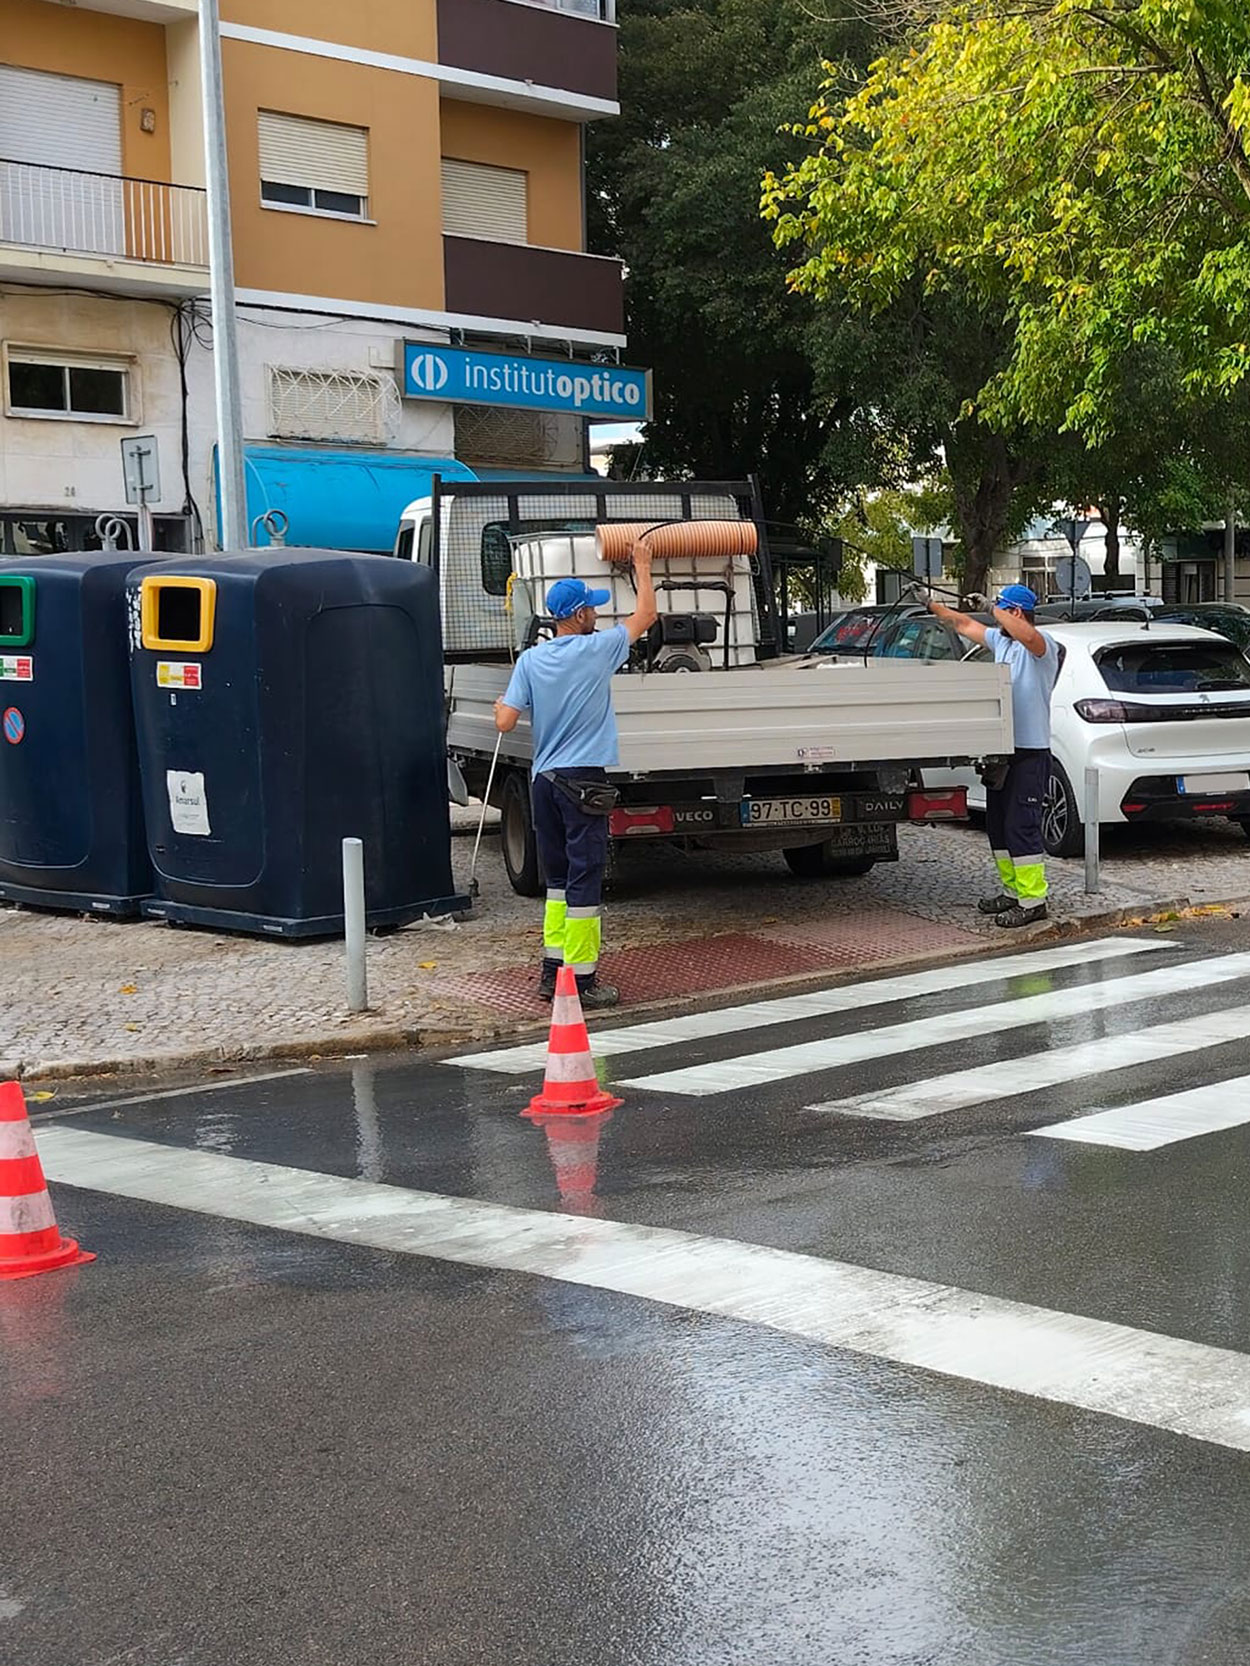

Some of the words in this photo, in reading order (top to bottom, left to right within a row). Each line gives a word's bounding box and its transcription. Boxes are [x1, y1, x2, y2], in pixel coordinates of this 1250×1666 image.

[465, 357, 640, 407] institutoptico
[865, 801, 904, 811] DAILY
[672, 810, 714, 822] IVECO
